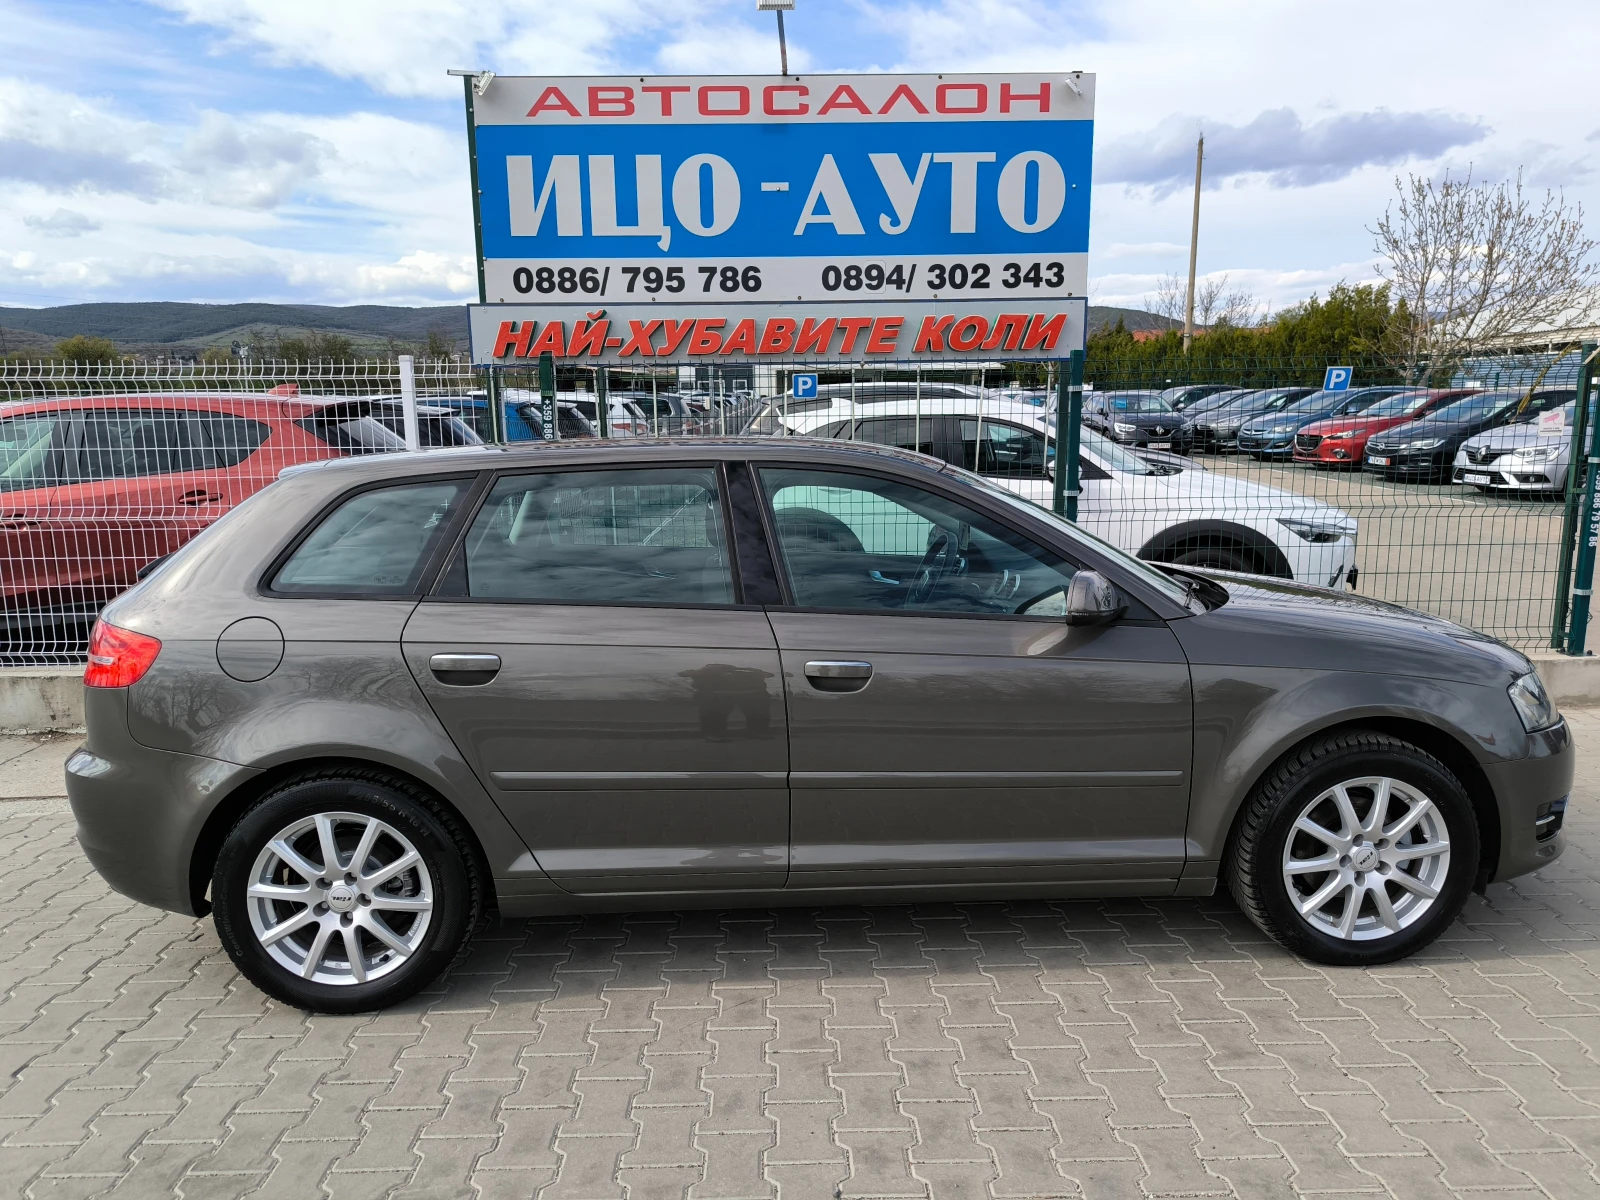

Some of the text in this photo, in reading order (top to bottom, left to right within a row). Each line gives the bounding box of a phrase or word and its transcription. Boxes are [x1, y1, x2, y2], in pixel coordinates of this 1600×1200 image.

[526, 83, 1052, 118] АВТОСАЛОН
[512, 262, 1065, 296] 0886/ 795 786 0894/ 302 343
[492, 310, 1068, 360] НАЙ-ХУБАВИТЕ КОЛИ
[543, 398, 554, 440] +359 886
